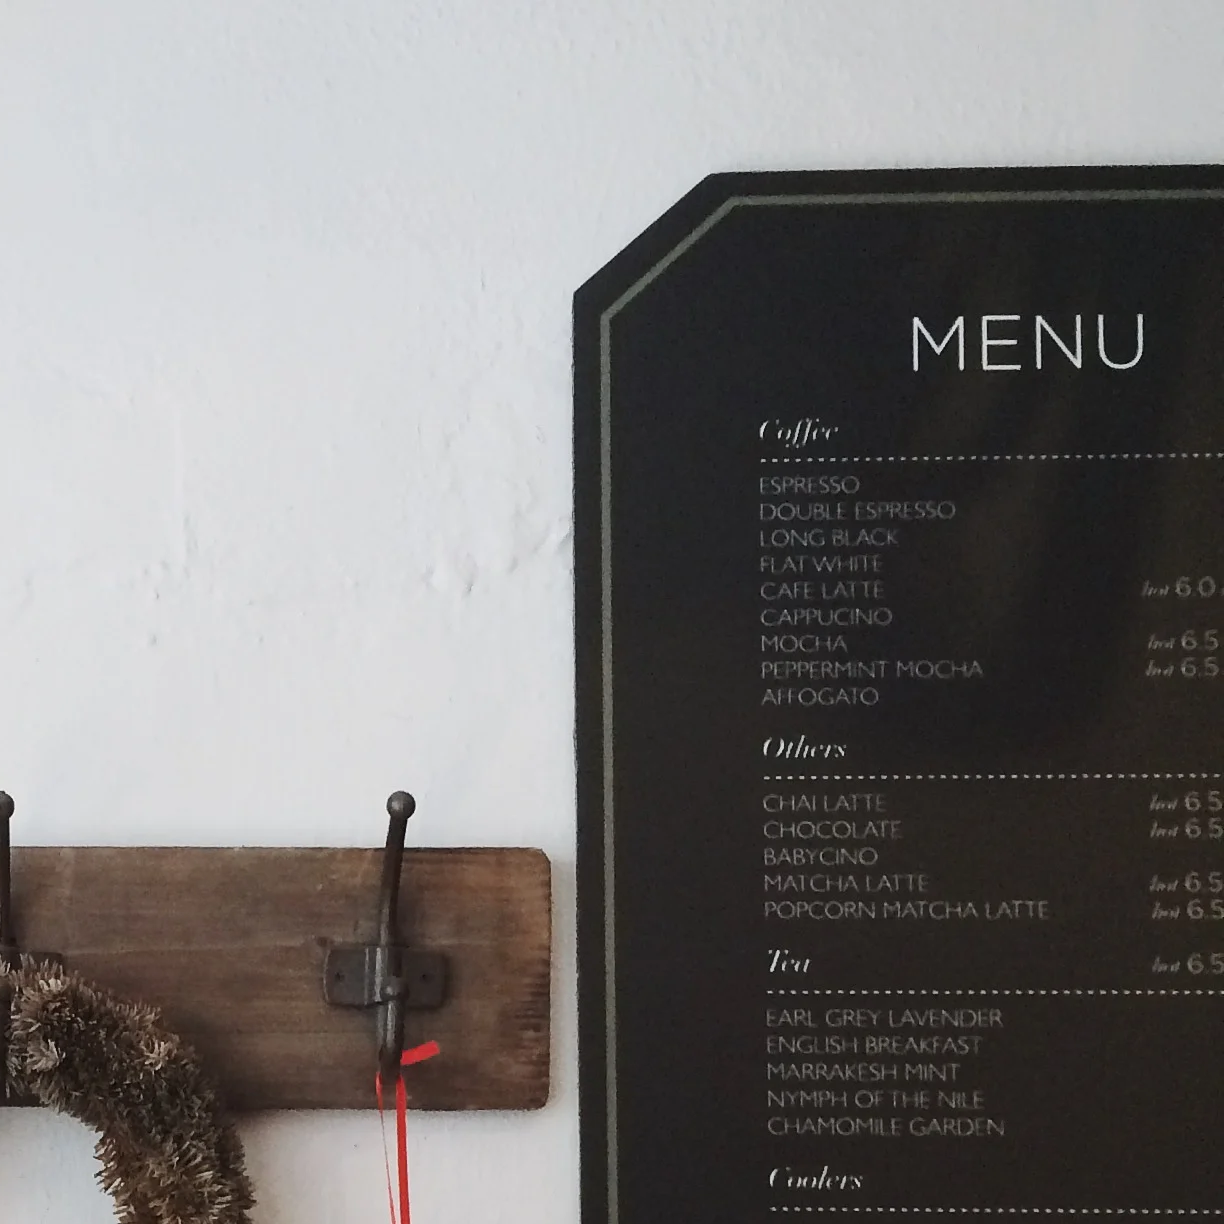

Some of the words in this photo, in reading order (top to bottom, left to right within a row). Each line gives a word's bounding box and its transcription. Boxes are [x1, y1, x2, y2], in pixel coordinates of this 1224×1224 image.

[911, 314, 1146, 371] MENU
[759, 419, 840, 448] Coffee
[759, 476, 860, 494] ESPRESSO
[760, 503, 848, 521] DOUBLE
[855, 501, 956, 520] ESPRESSO
[760, 529, 826, 547] LONG
[832, 528, 899, 546] BLACK
[760, 556, 810, 573] FLAT
[812, 555, 883, 572] WHITE
[760, 582, 816, 600] CAFE
[822, 581, 885, 599] LATTE
[760, 608, 893, 626] CAPPUCINO
[761, 635, 848, 652] MOCHA
[761, 660, 889, 679] PEPPERMINT
[896, 660, 984, 678] MOCHA
[761, 687, 879, 705] AFFOGATO
[763, 735, 847, 758] Others
[762, 794, 818, 812] CHAI
[823, 794, 887, 812] LATTE
[763, 820, 902, 839] CHOCOLATE
[763, 848, 878, 865] BABYCINO
[763, 874, 858, 892] MATCHA
[865, 874, 929, 892] LATTE
[764, 901, 876, 919] POPCORN
[883, 901, 979, 919] MATCHA
[985, 900, 1049, 919] LATTE
[767, 950, 812, 972] Tea
[765, 1009, 818, 1027] EARL
[825, 1009, 883, 1027] GREY
[888, 1009, 1004, 1027] LAVENDER
[766, 1036, 859, 1054] ENGLISH
[865, 1036, 982, 1054] BREAKFAST
[766, 1063, 899, 1081] MARRAKESH
[904, 1063, 960, 1081] MINT
[767, 1090, 849, 1107] NYMPH
[854, 1090, 884, 1108] OF
[890, 1090, 930, 1109] THE
[937, 1091, 985, 1109] NILE
[767, 1117, 902, 1136] CHAMOMILE
[909, 1117, 1006, 1136] GARDEN
[768, 1166, 863, 1189] Coolers
